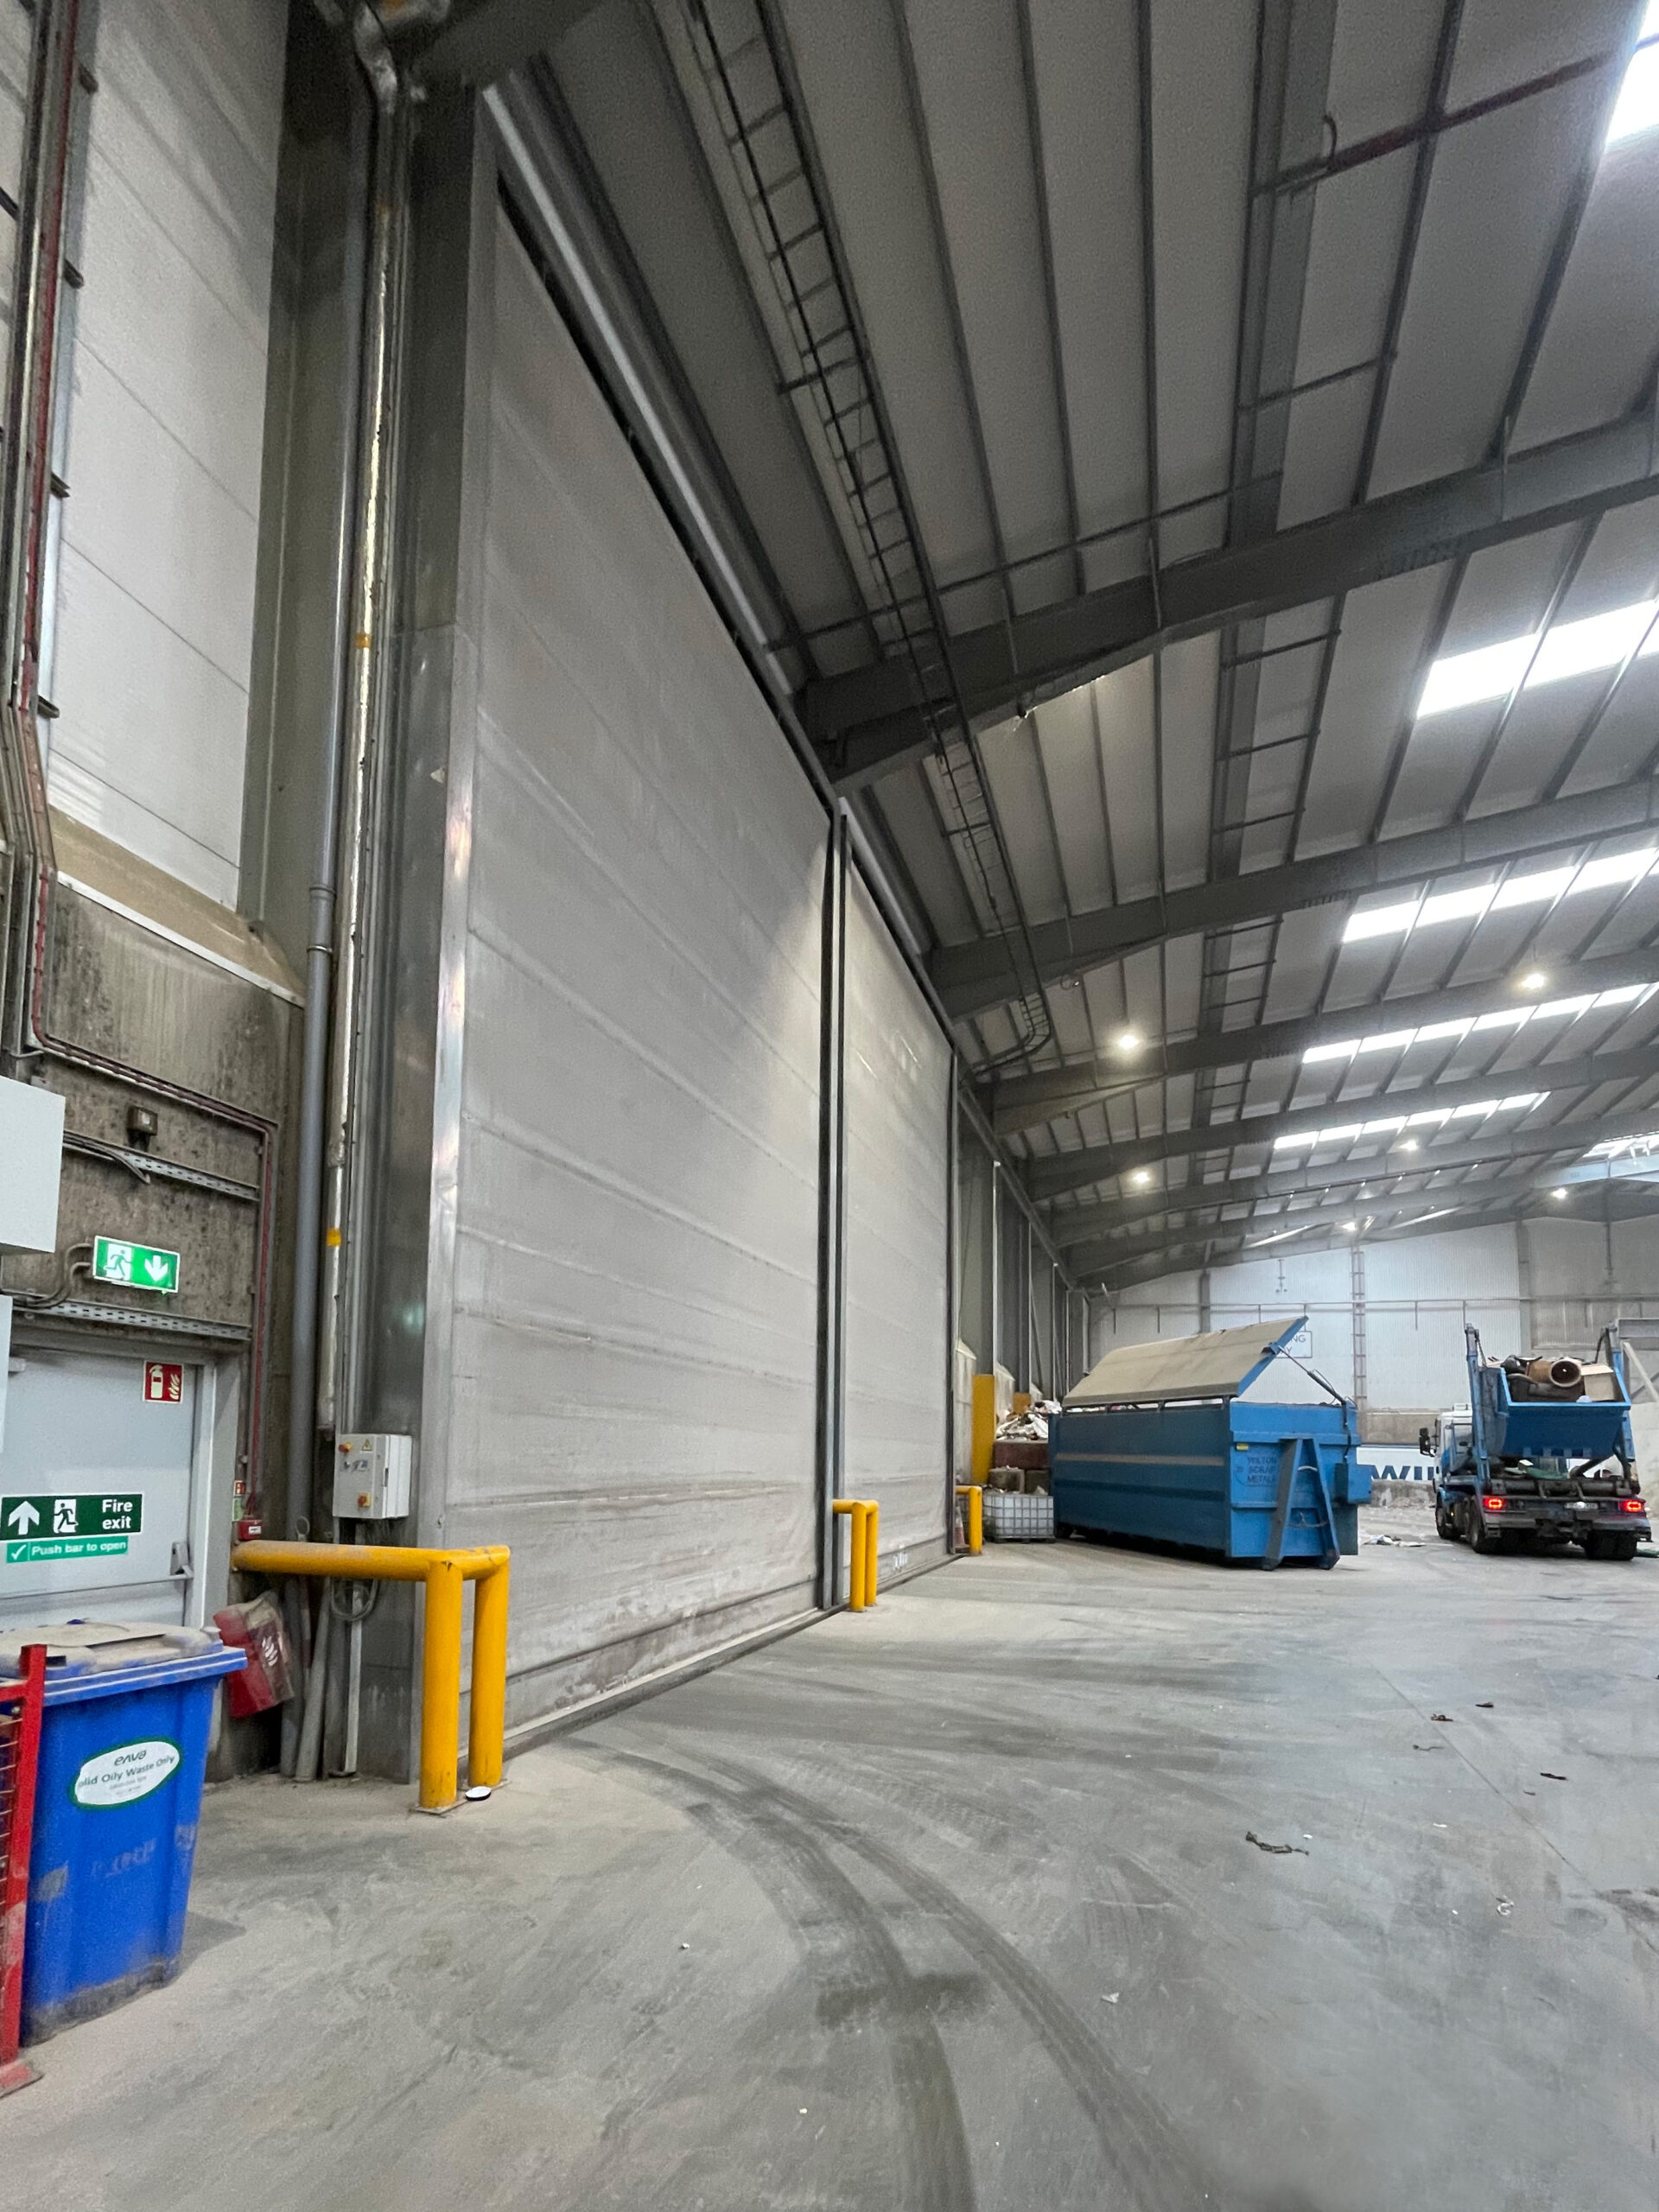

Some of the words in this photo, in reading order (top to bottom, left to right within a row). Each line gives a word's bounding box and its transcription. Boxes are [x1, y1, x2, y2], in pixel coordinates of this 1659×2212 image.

[102, 1499, 133, 1513] Fire
[102, 1516, 132, 1530] exit
[31, 1544, 62, 1556] Push
[65, 1543, 84, 1554] bar
[86, 1542, 97, 1551] to
[99, 1541, 126, 1552] open
[78, 1776, 99, 1789] olid
[101, 1771, 124, 1783] Oily
[125, 1763, 154, 1777] Waste
[156, 1755, 175, 1768] Only
